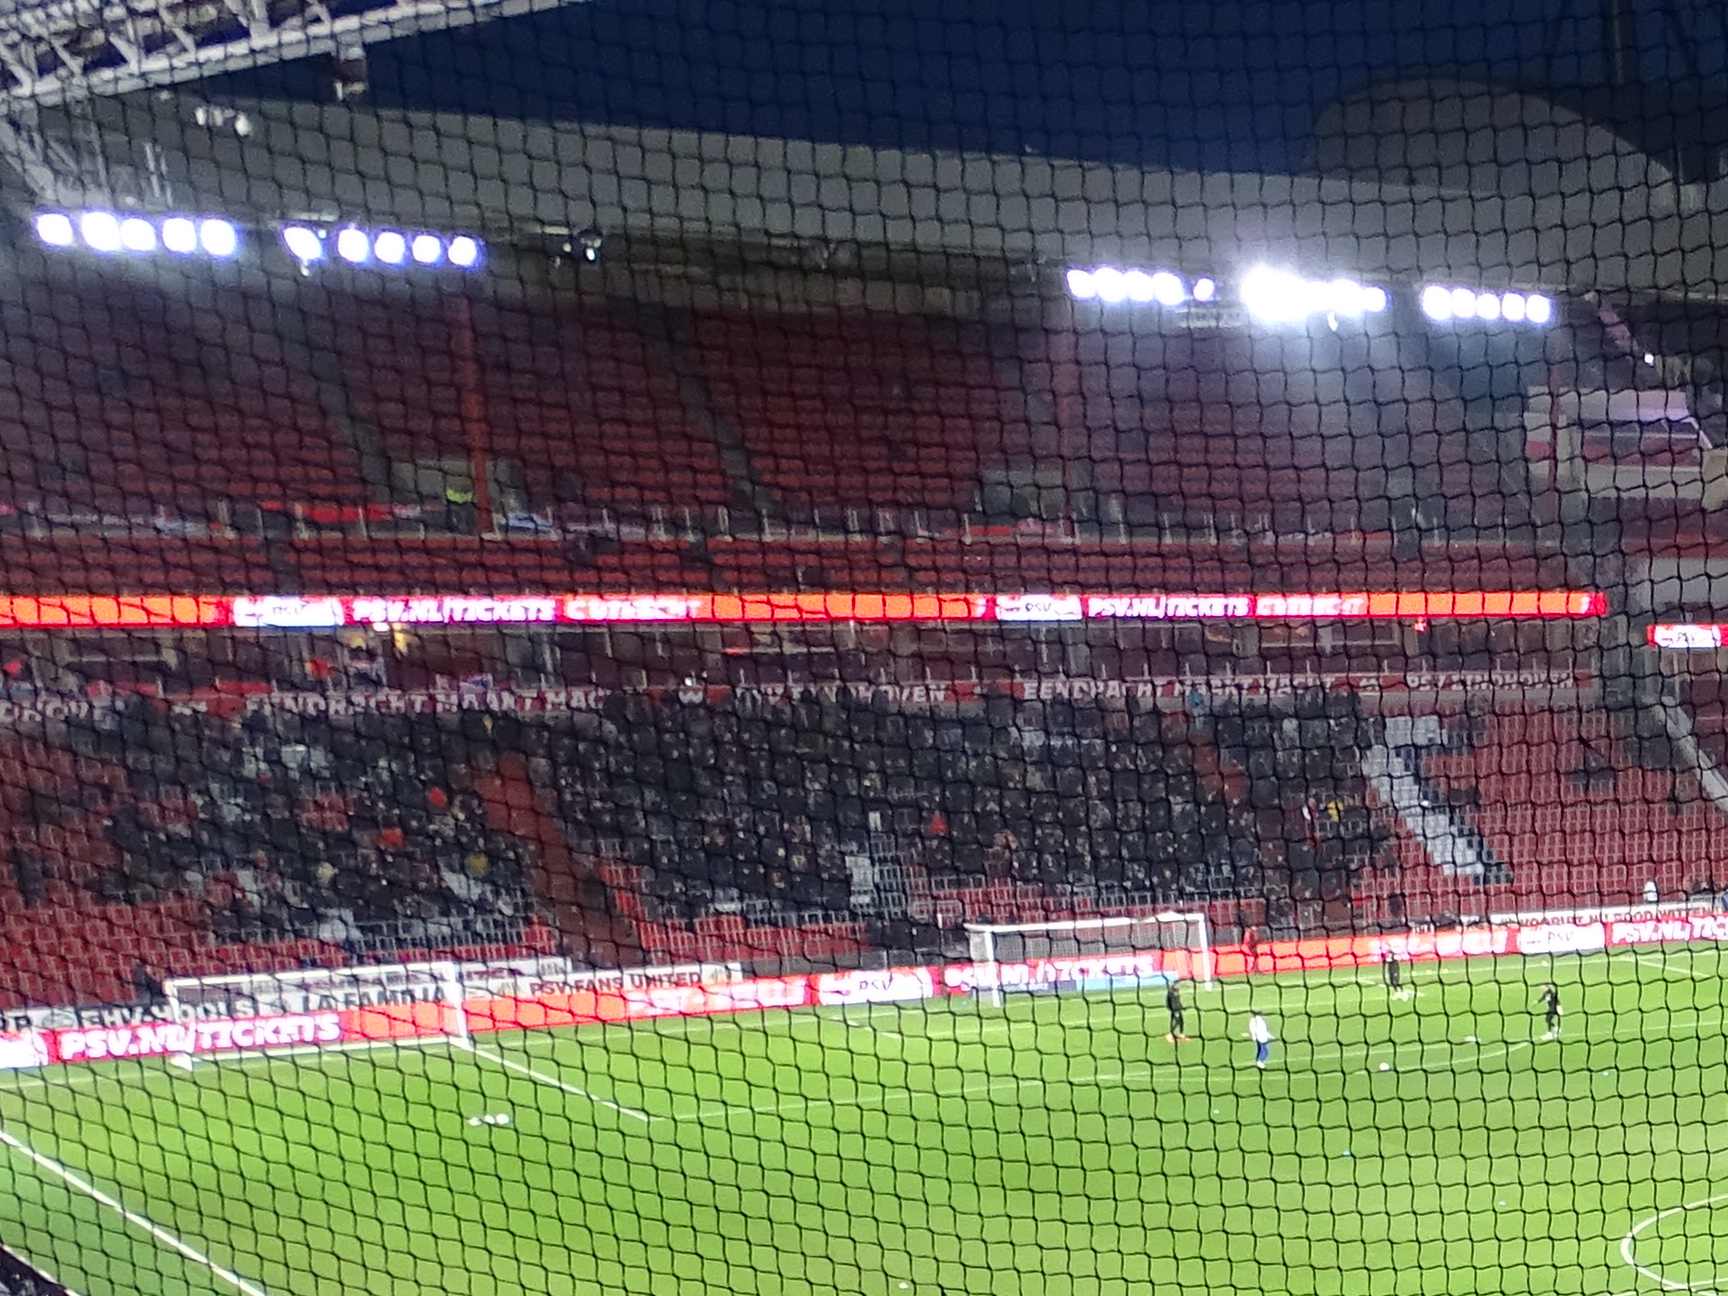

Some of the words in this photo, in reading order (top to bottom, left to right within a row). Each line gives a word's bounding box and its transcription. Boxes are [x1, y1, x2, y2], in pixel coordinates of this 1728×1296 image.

[353, 600, 556, 623] PSV.NL/TICKETS
[1088, 599, 1249, 619] PSV.NL/TICKETS
[61, 1013, 341, 1060] PSV.NL/TICKETS
